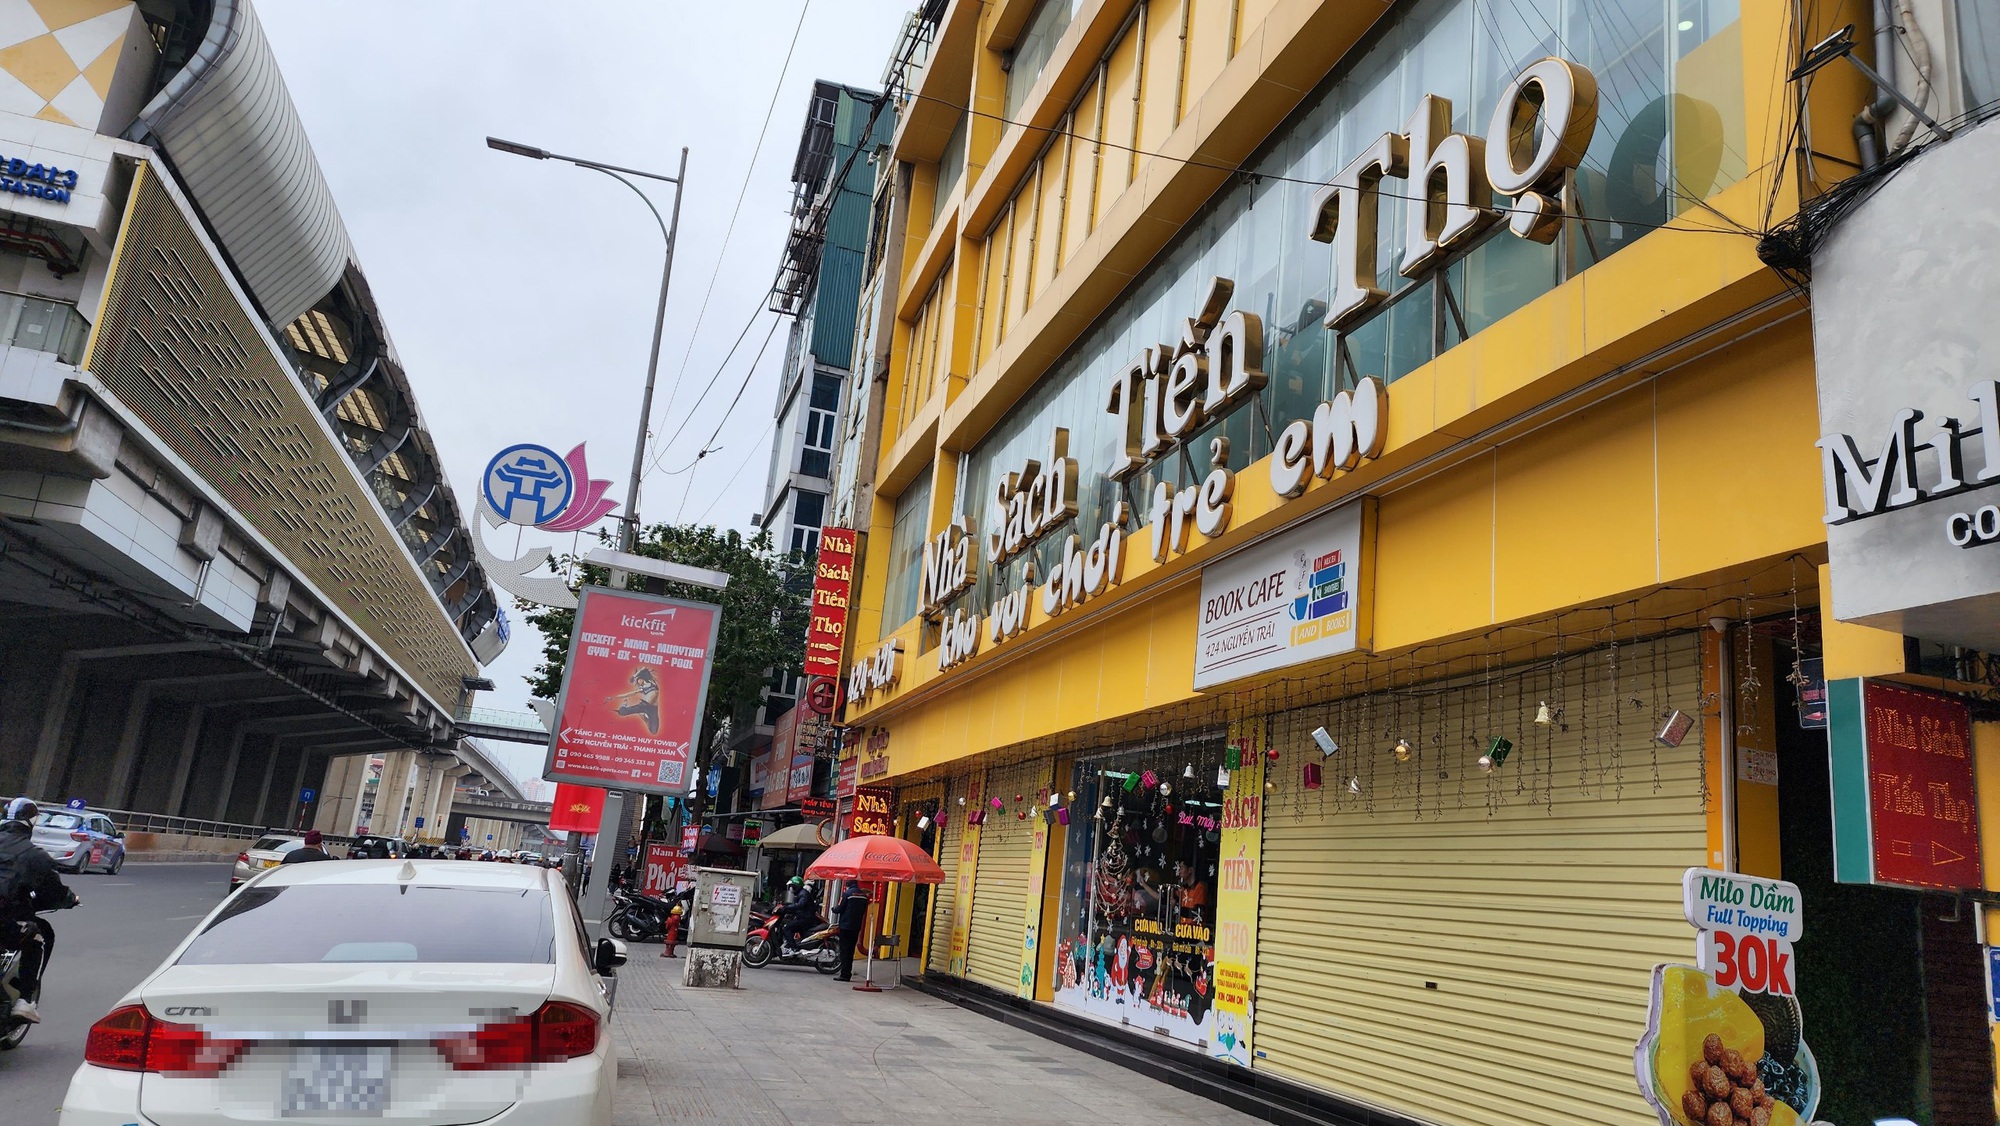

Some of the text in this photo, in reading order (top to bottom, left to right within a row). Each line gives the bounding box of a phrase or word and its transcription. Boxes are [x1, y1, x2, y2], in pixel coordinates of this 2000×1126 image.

[0, 177, 71, 204] TATION
[919, 56, 1598, 616] Nhà Sách Tiến Thọ
[1043, 501, 1128, 617] chơi
[1151, 436, 1235, 564] trẻ
[1270, 375, 1388, 498] em
[824, 535, 851, 553] Nhà
[819, 562, 849, 580] Sách
[816, 588, 846, 608] Tiến
[1205, 570, 1286, 624] BOOK CAFE
[621, 615, 667, 632] kickfit
[814, 616, 842, 637] Thọ
[1299, 615, 1346, 639] AND BOOKS
[581, 632, 704, 659] KICKFIT MMA MUAYTHAI
[1205, 621, 1275, 658] 424 NGUYỄN TRÃI
[587, 645, 693, 669] GYM GX YOGA POOL
[653, 739, 677, 748] TOWER
[1874, 706, 1965, 759] Nhà Sách
[633, 746, 656, 754] THANH
[857, 795, 887, 813] Nhà
[1928, 782, 1970, 834] Thọ
[853, 817, 886, 835] Sách
[652, 848, 673, 857] Nam
[645, 861, 677, 891] Phở
[1700, 876, 1795, 914] Milo Dầm
[1175, 918, 1210, 942] CỬA VÀO
[1707, 905, 1788, 937] Full Topping
[1222, 921, 1249, 964] THỌ
[1714, 931, 1792, 995] 30k
